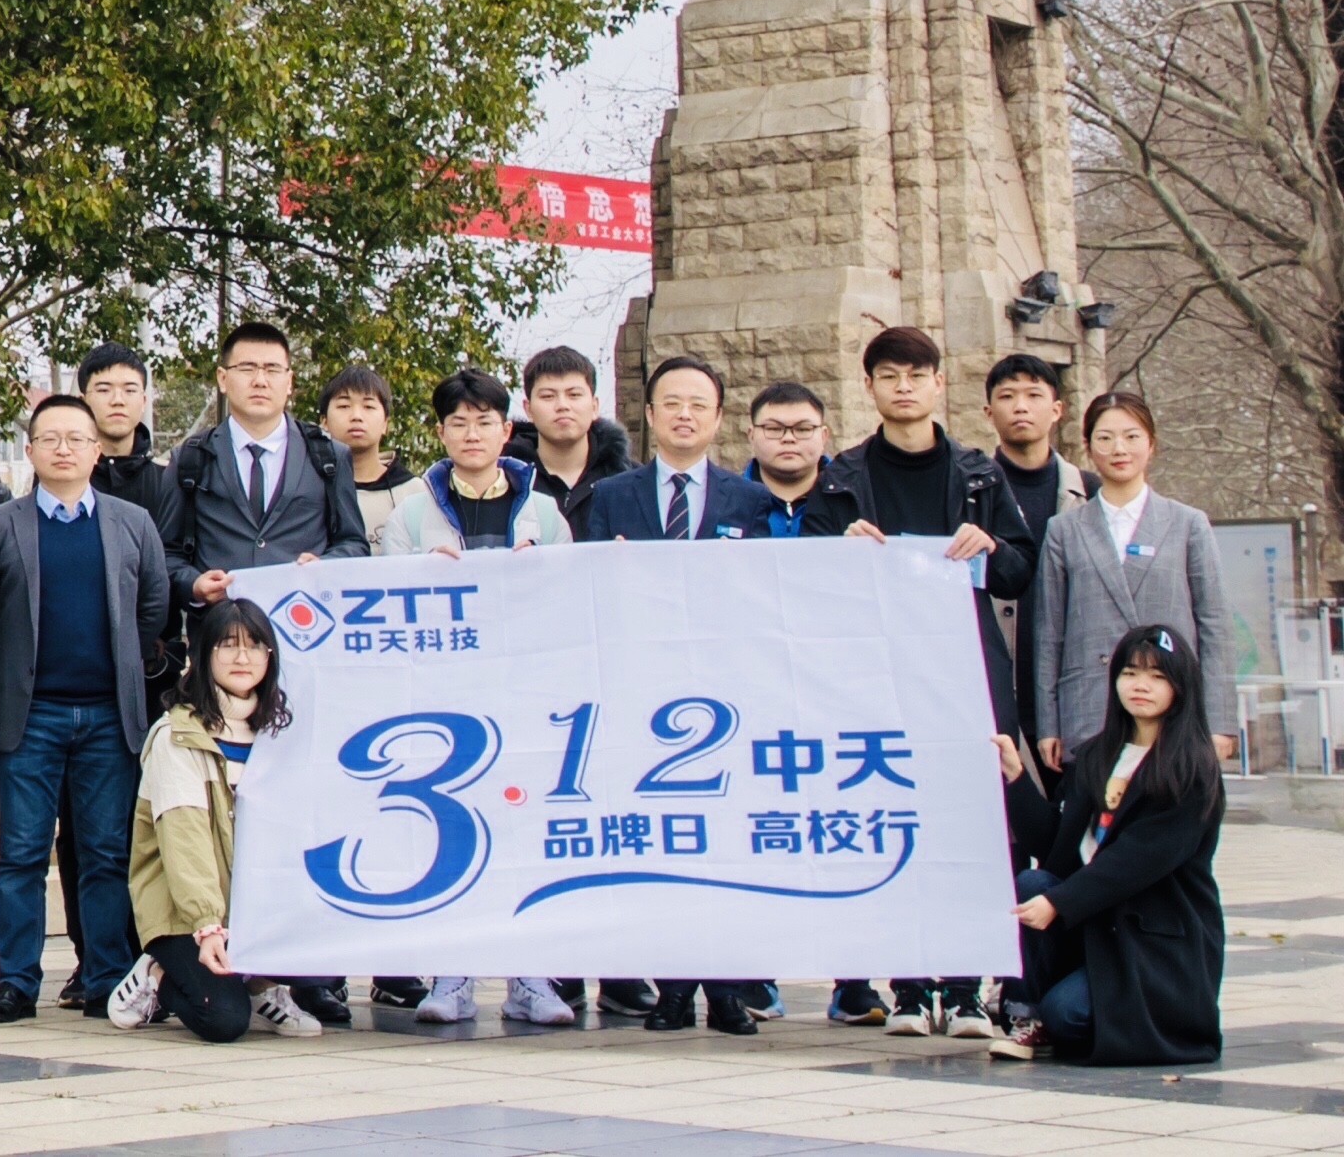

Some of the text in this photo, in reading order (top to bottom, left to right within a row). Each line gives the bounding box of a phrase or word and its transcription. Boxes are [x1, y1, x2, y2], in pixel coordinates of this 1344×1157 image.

[341, 585, 479, 626] ZTT
[343, 627, 481, 654] 中天科技
[543, 809, 921, 859] 品牌日 高校行
